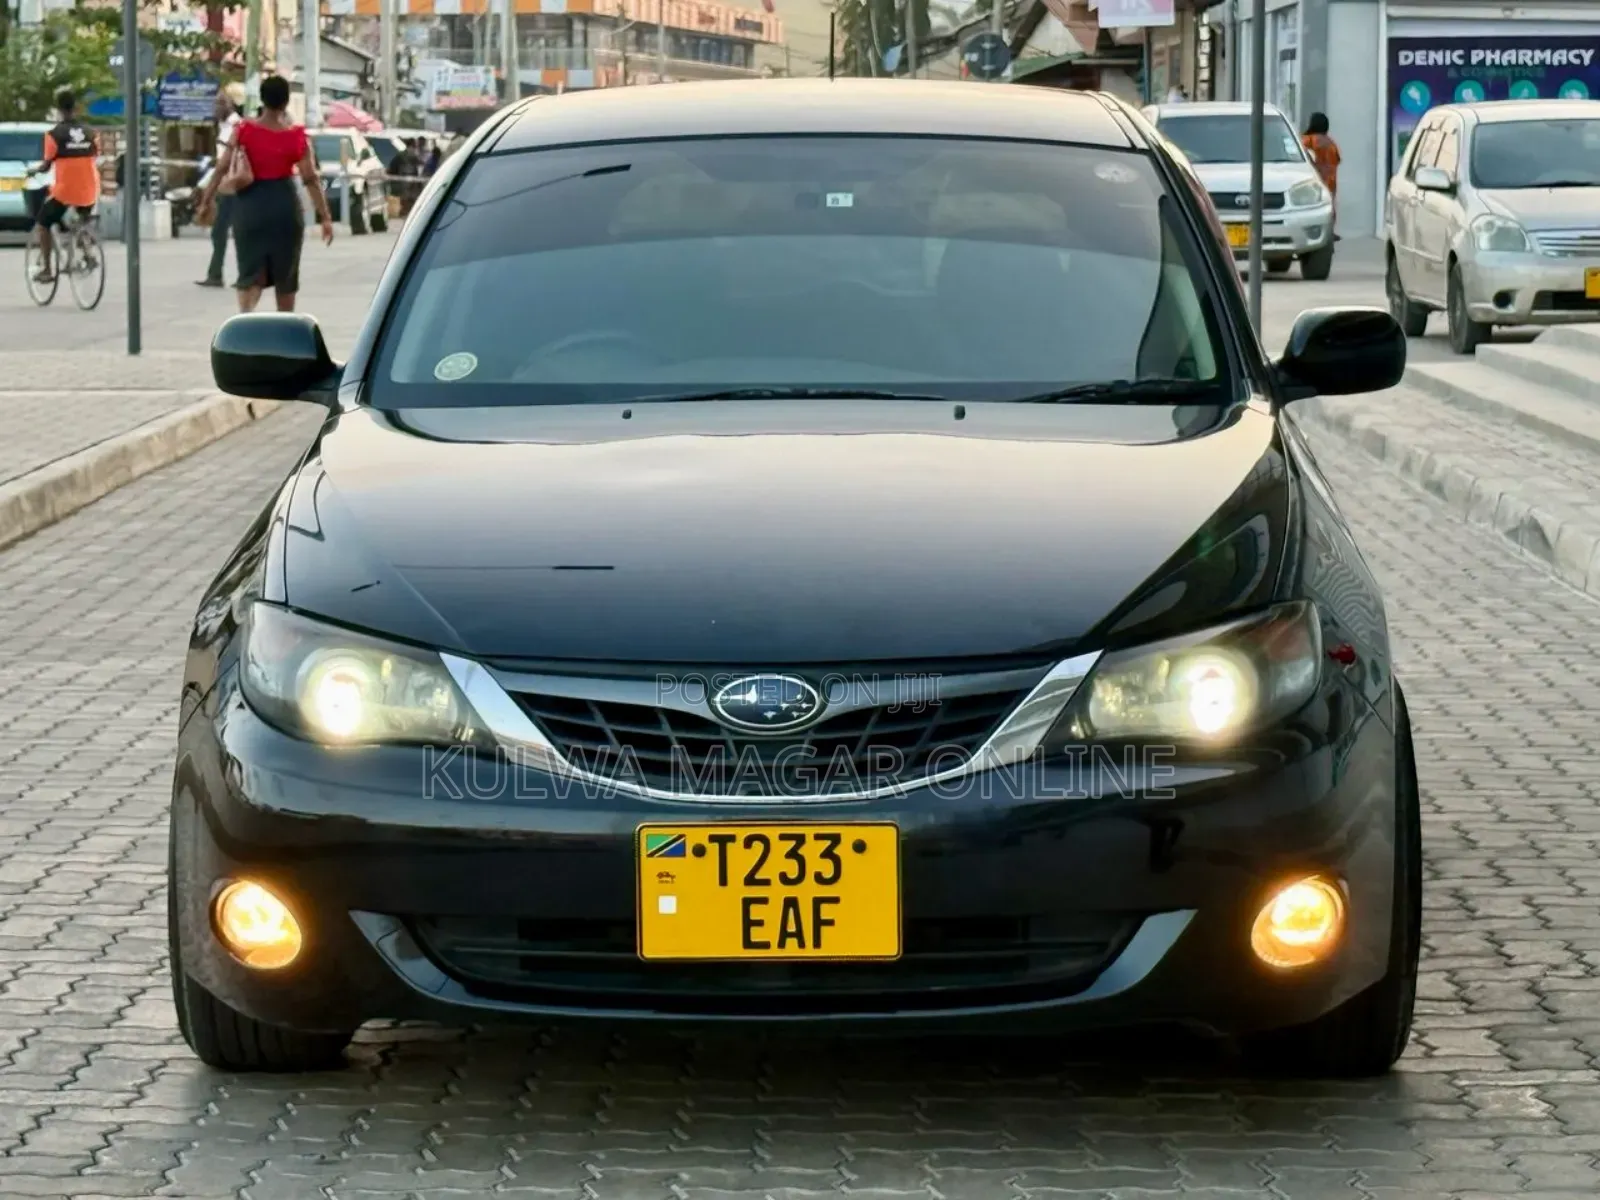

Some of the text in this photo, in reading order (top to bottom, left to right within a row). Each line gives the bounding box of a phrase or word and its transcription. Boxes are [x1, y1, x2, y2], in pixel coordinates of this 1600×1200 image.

[1398, 49, 1594, 66] DENIC PHARMACY
[708, 833, 842, 887] T233
[741, 896, 841, 949] EAF
